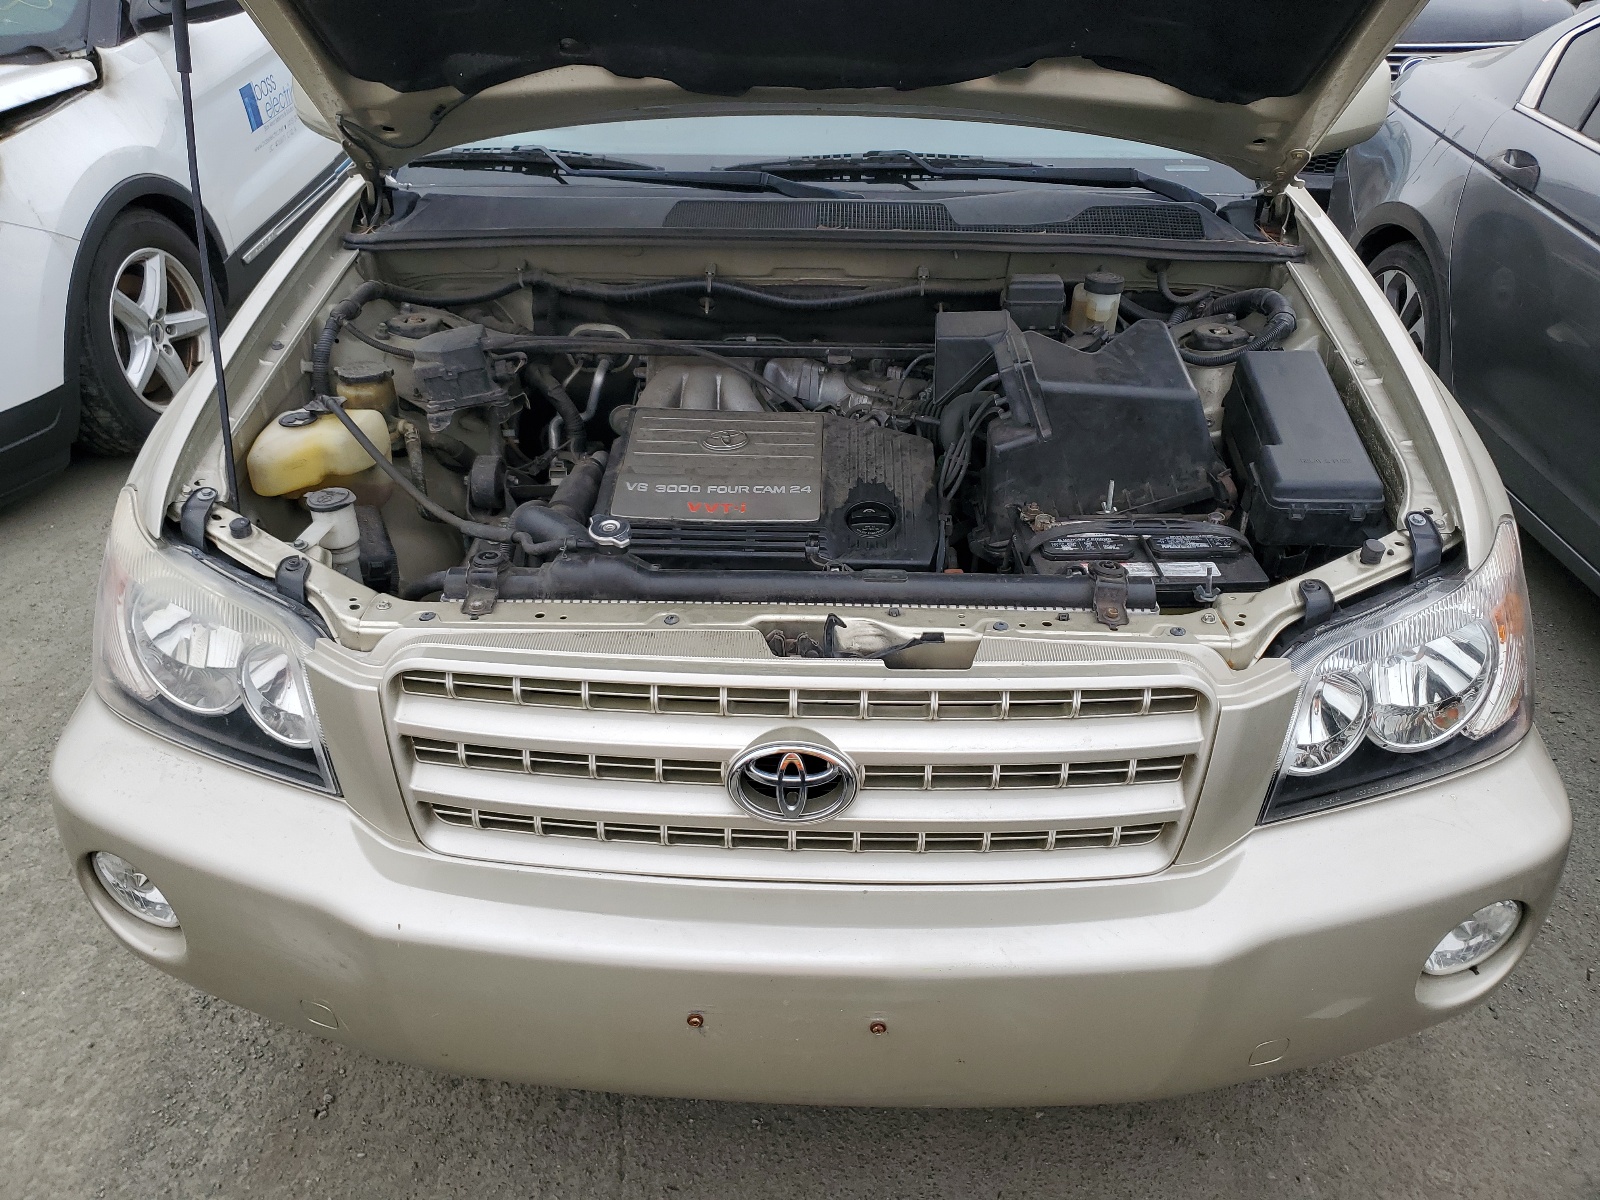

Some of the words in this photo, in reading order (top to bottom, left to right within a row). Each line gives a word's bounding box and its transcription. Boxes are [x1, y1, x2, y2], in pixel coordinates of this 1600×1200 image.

[265, 83, 294, 119] electri
[625, 481, 649, 492] V6
[655, 484, 701, 494] 3000
[707, 485, 750, 494] FOUR
[752, 485, 786, 494] CAM
[789, 485, 812, 494] 24
[687, 501, 747, 513] VVT-i
